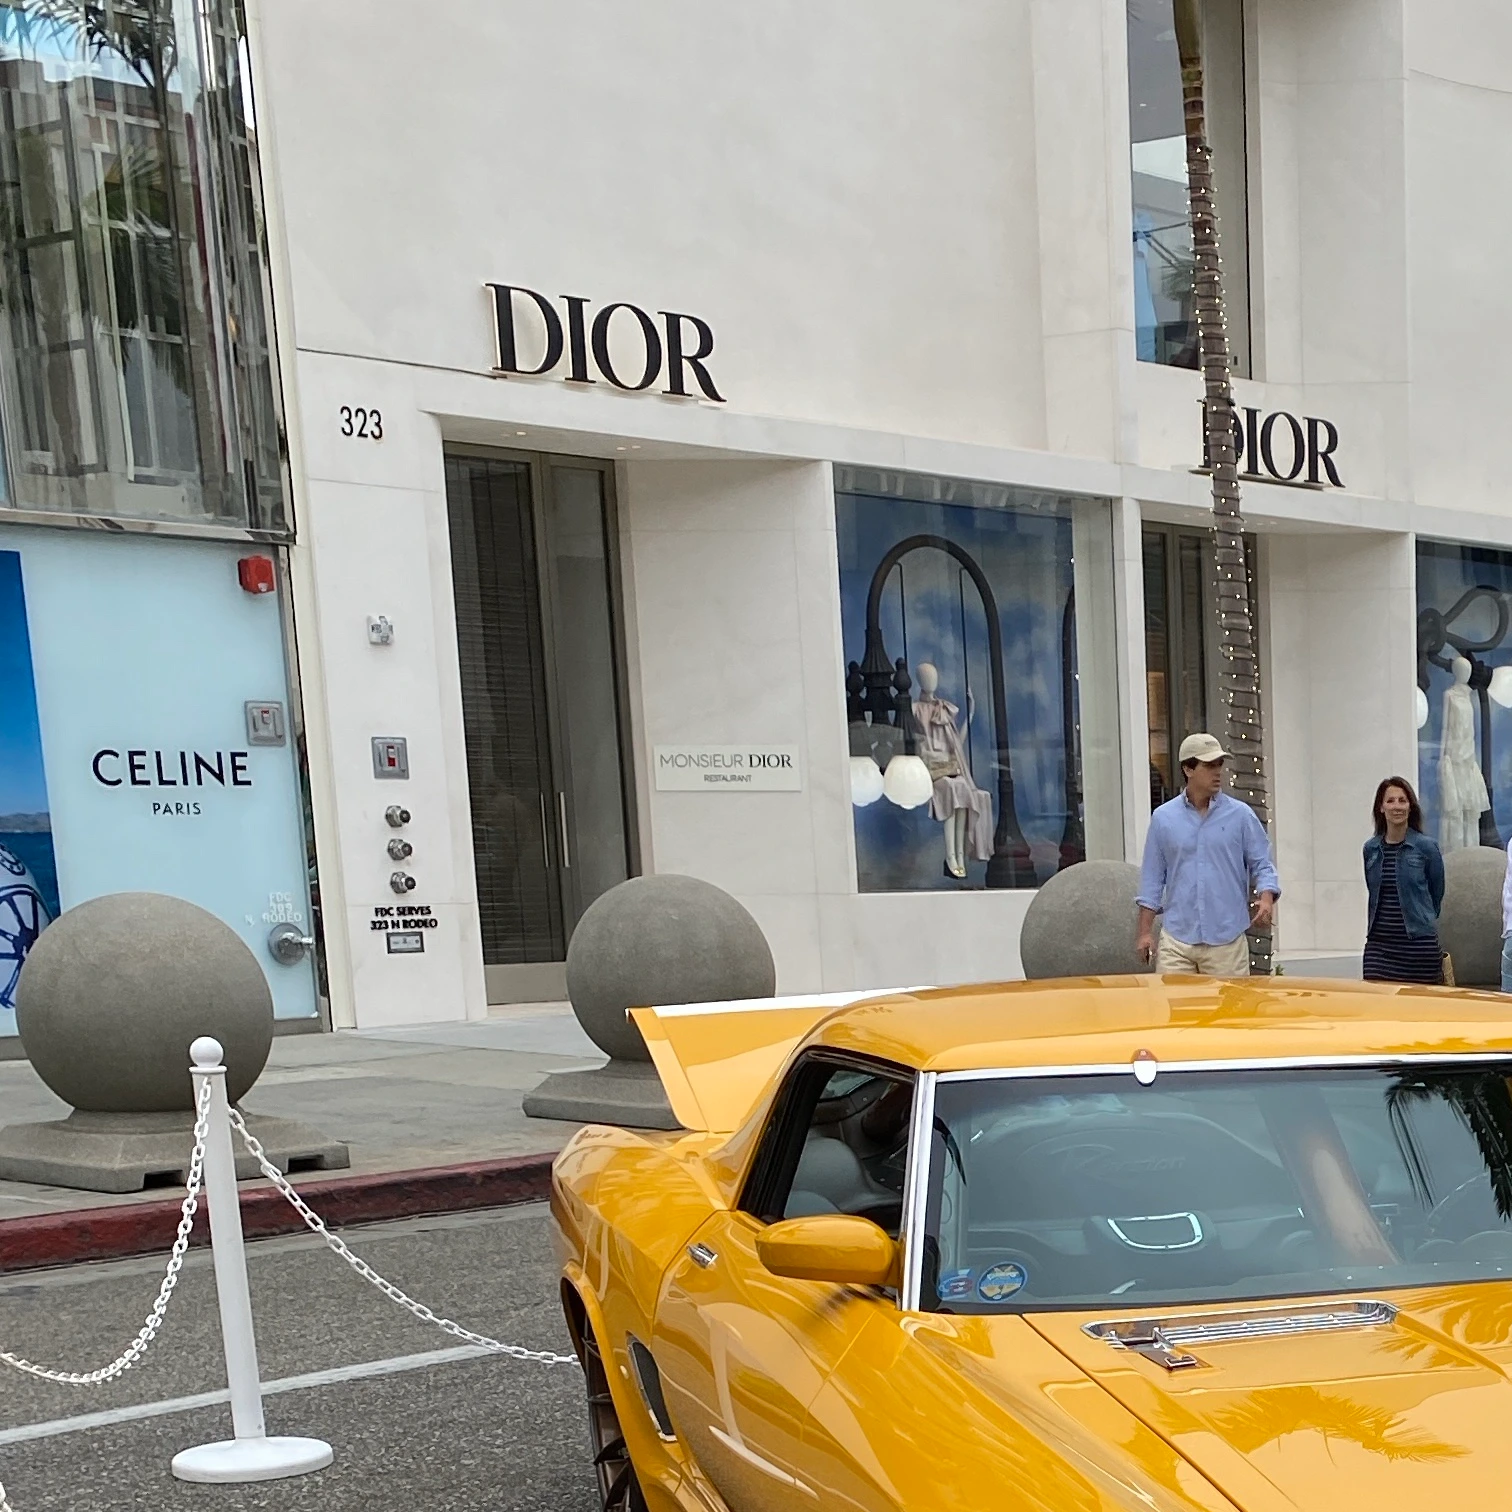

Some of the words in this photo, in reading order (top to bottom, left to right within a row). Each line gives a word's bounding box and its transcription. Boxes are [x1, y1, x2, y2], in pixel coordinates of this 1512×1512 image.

[485, 283, 727, 402] DIOR
[339, 405, 383, 440] 323
[660, 753, 743, 768] MONSIEUR
[749, 753, 793, 768] DIOR
[92, 749, 252, 787] CELINE
[703, 774, 752, 783] RESTAURANT
[152, 802, 202, 815] PARIS
[374, 906, 394, 918] FDC
[396, 905, 432, 917] SERVES
[370, 919, 389, 930] 323
[391, 919, 401, 930] N
[402, 917, 438, 929] RODEO
